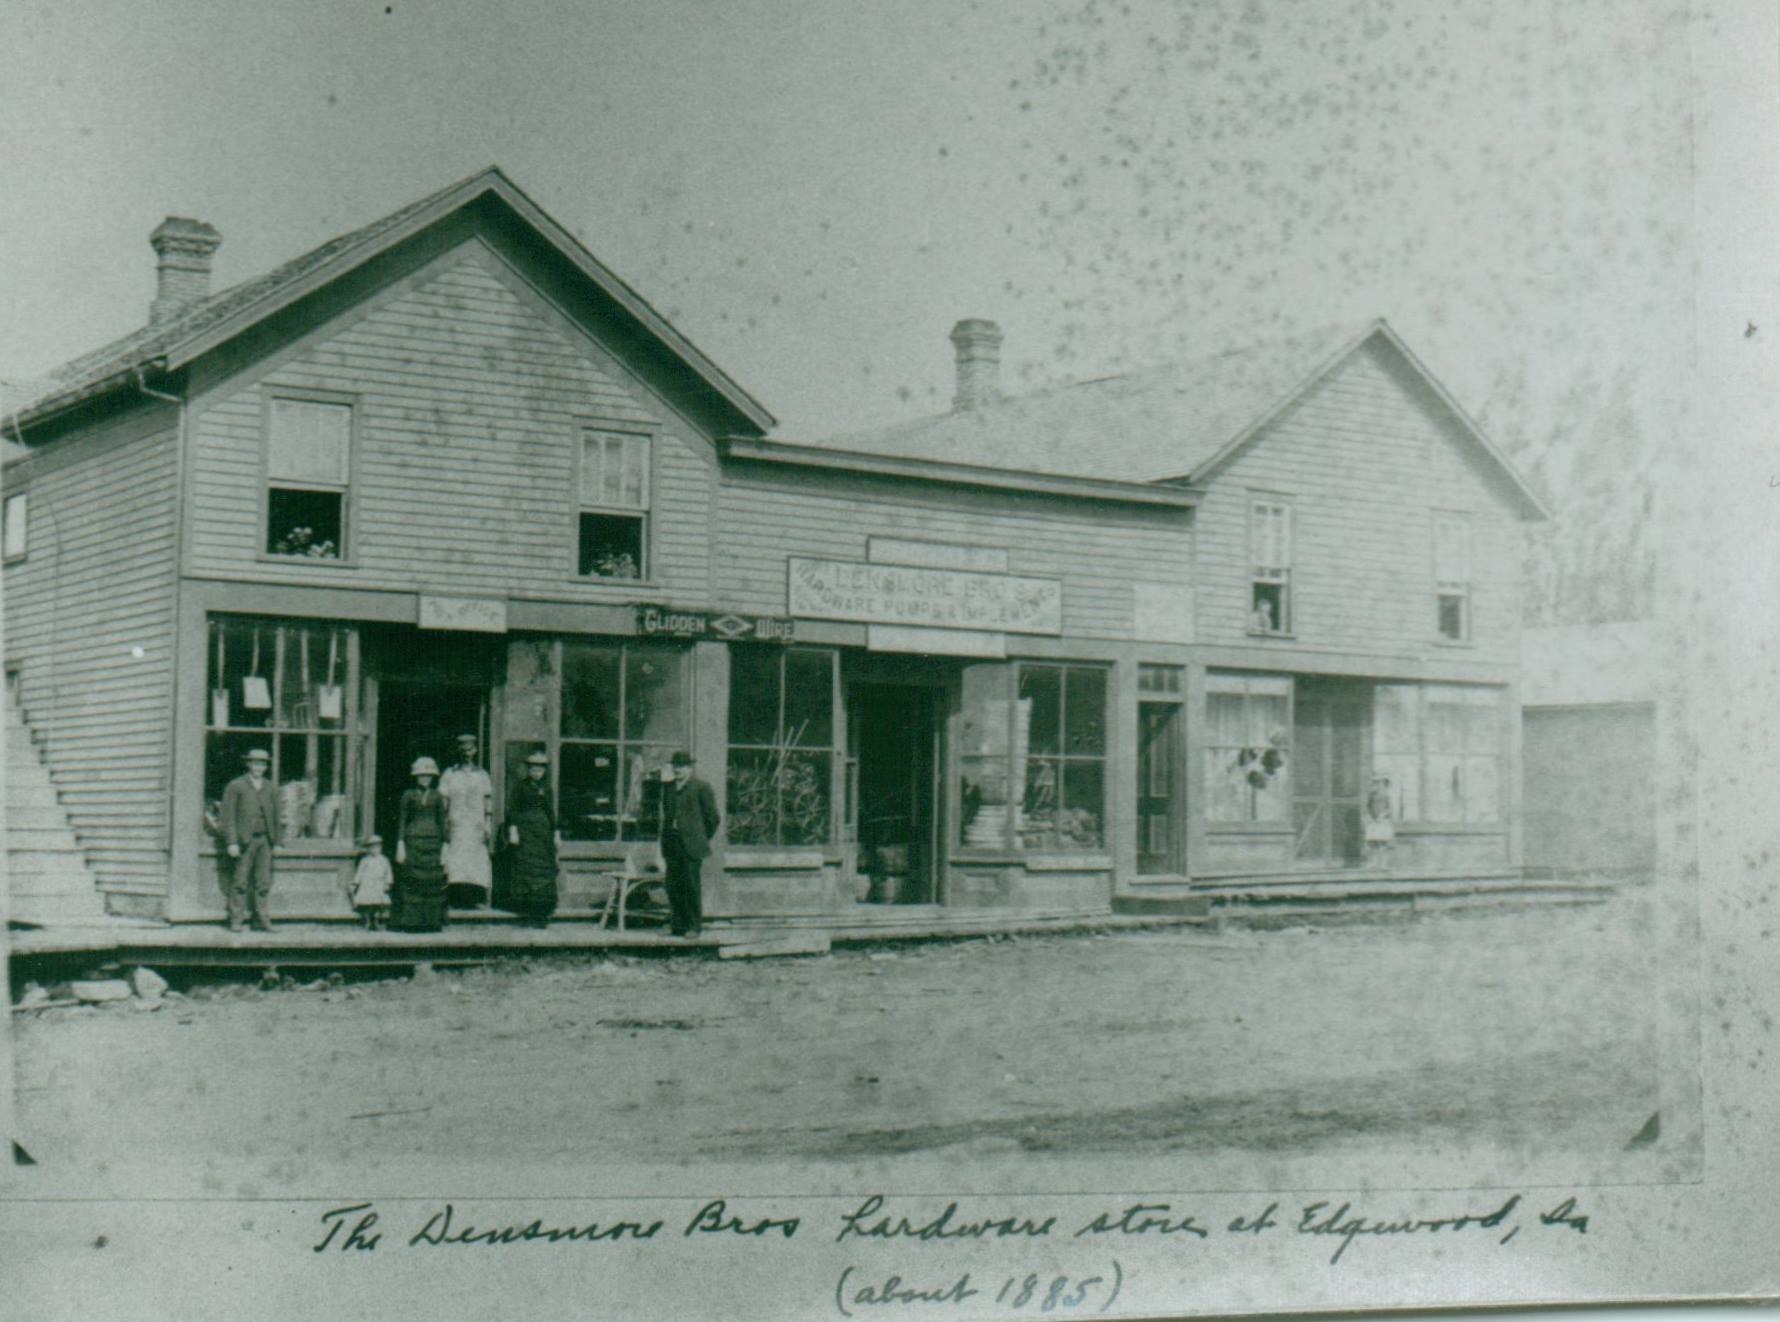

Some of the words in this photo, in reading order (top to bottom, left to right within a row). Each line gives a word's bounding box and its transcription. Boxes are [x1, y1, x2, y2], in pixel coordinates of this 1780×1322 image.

[645, 609, 707, 633] GLIDDEN
[756, 618, 795, 638] WIRE
[313, 1203, 382, 1253] The
[408, 1203, 664, 1247] Densmore
[684, 1200, 801, 1239] Bros
[1228, 1203, 1278, 1234] at
[1298, 1194, 1521, 1265] Edgewood,
[835, 1266, 979, 1317] (about
[995, 1260, 1123, 1312] 1885)
